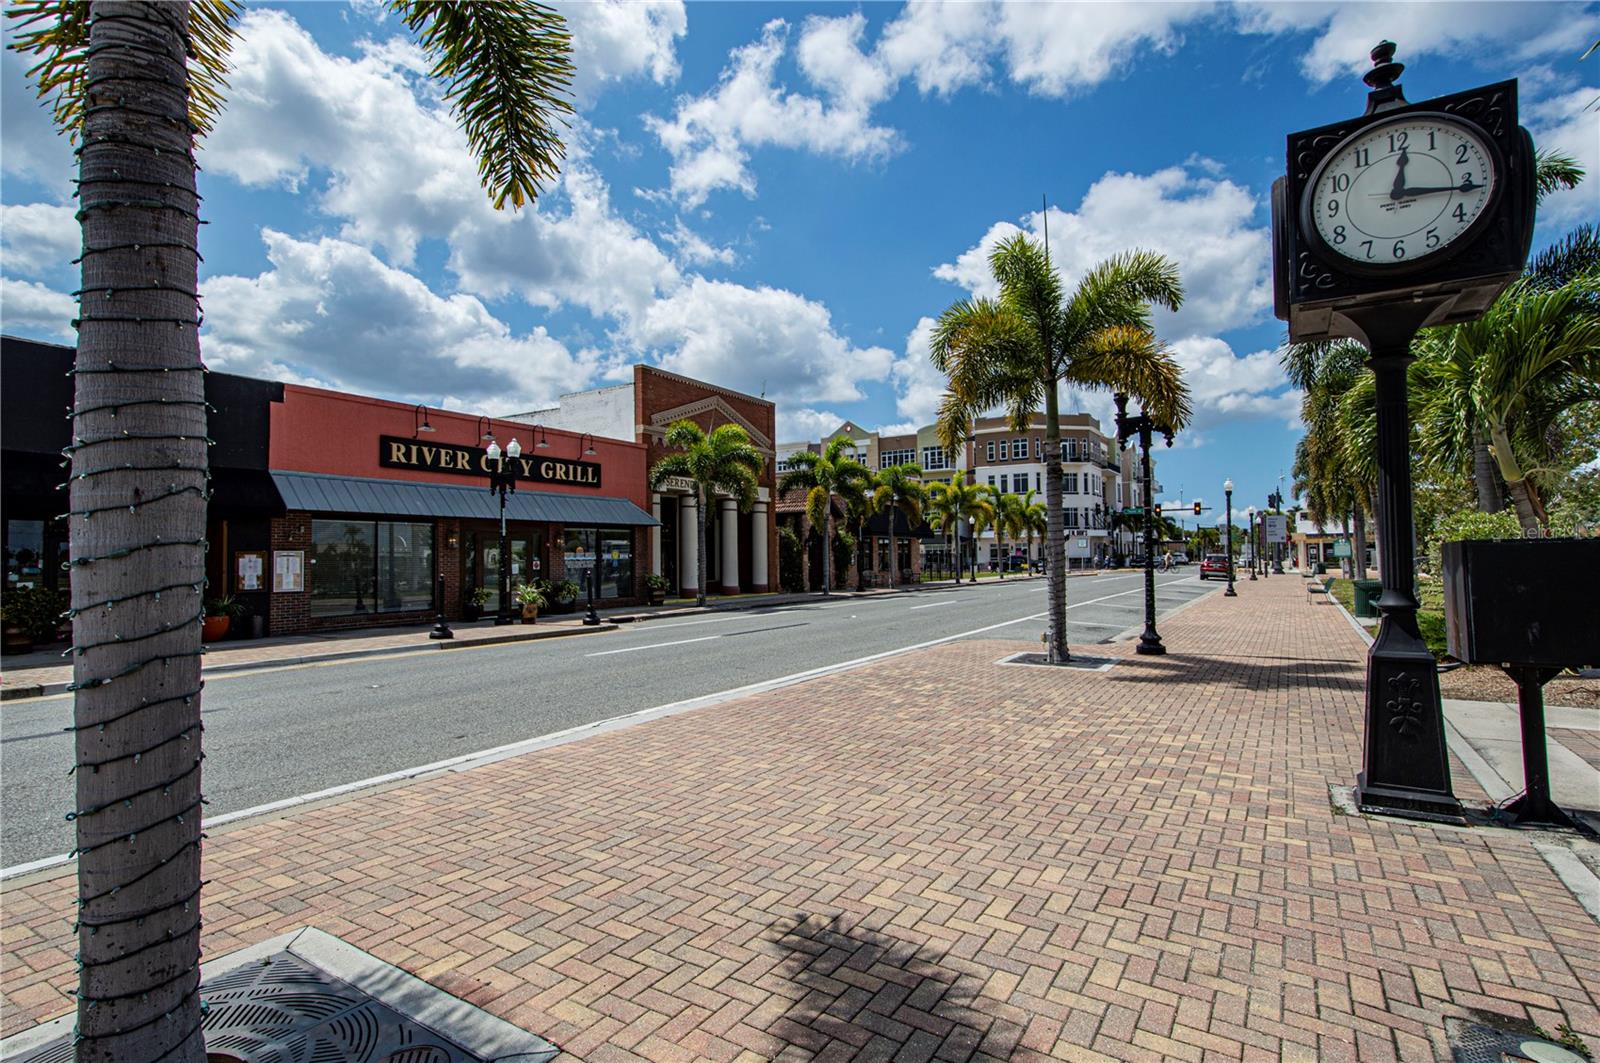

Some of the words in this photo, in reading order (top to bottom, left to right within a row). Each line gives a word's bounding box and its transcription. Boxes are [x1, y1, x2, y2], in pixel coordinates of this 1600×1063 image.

[1388, 131, 1409, 152] 12
[1428, 131, 1437, 150] 1
[1354, 148, 1370, 168] 11
[1455, 143, 1469, 164] 2
[1330, 172, 1350, 193] 10
[1327, 199, 1339, 218] 9
[1452, 203, 1467, 223] 4
[1333, 225, 1347, 245] 8
[1426, 226, 1440, 248] 5
[1360, 240, 1376, 259] 7
[1393, 239, 1405, 258] 6
[389, 442, 471, 470] RIVER
[480, 455, 533, 477] CIY
[541, 461, 597, 483] GRILL
